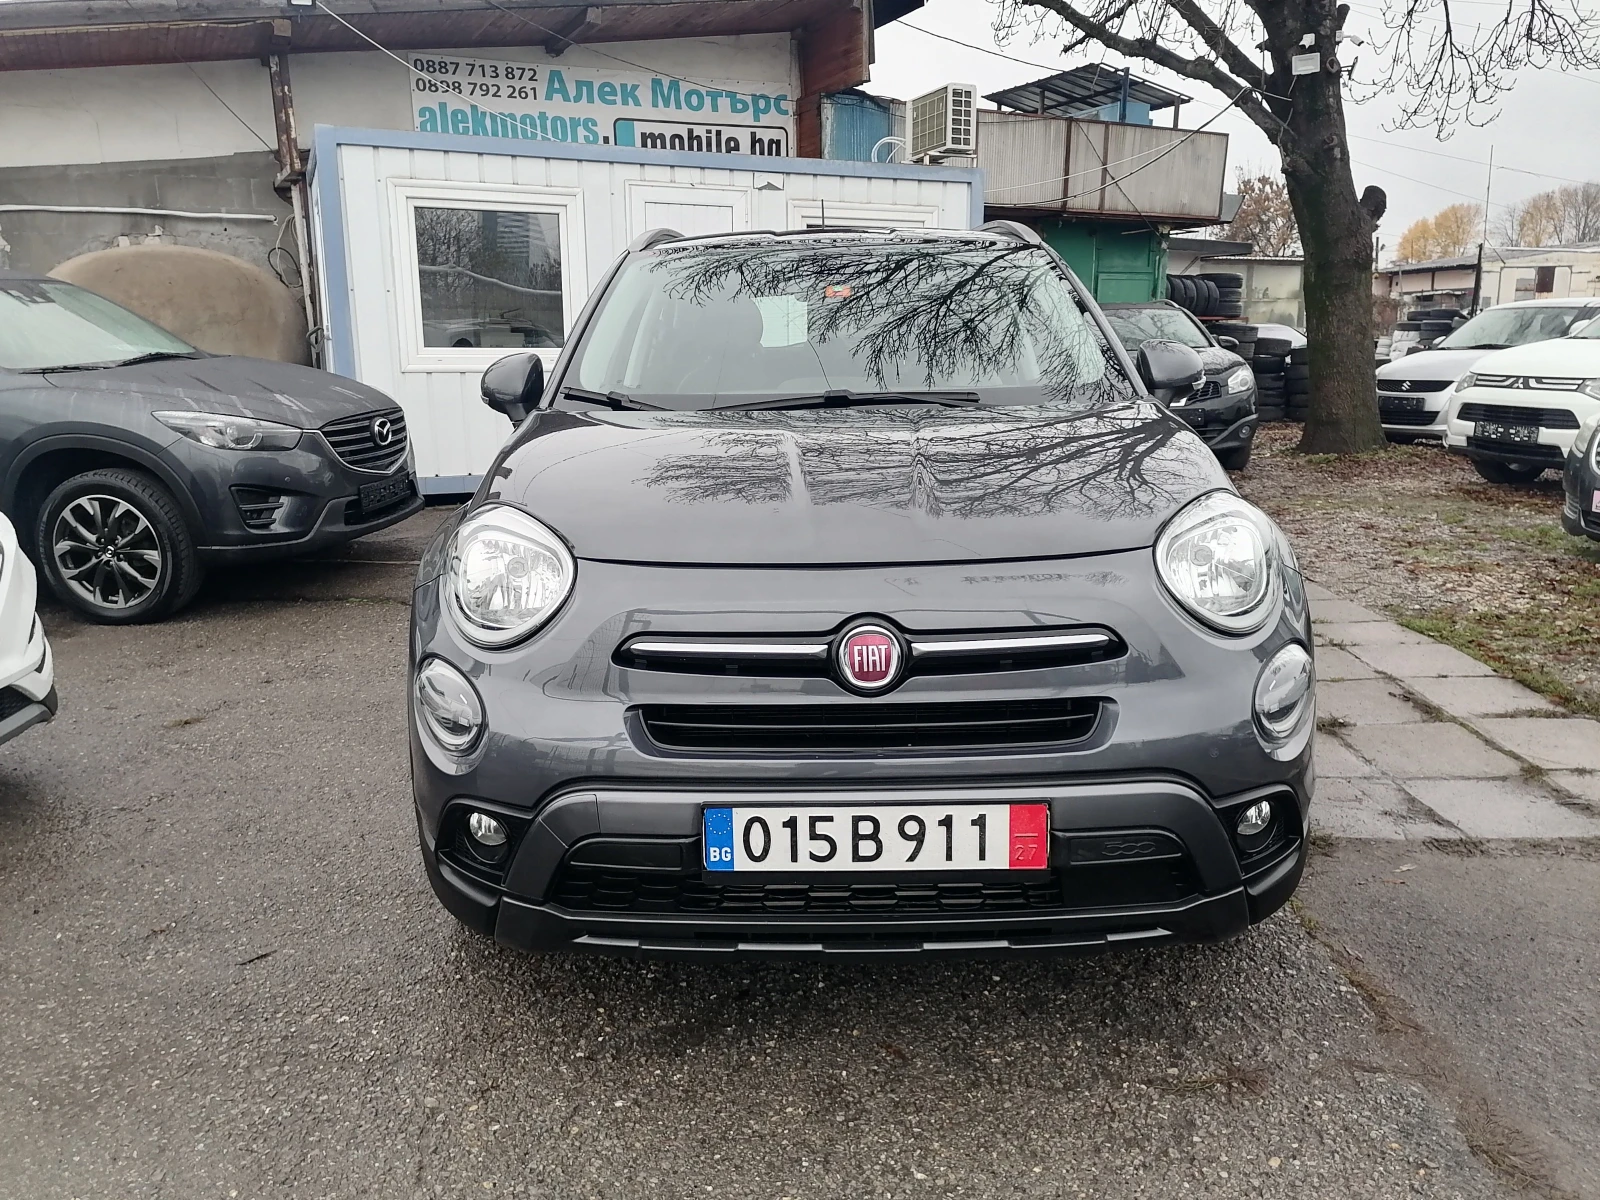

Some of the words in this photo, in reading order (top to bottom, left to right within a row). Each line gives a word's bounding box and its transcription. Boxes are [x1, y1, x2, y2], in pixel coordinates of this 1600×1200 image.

[413, 58, 460, 76] 0887
[465, 63, 500, 79] 713
[504, 66, 539, 82] 872
[415, 78, 463, 95] 0898
[467, 82, 502, 98] 792
[506, 85, 539, 101] 261
[544, 69, 642, 107] Алек
[651, 77, 790, 122] Мотърс
[853, 644, 888, 672] FIAT
[709, 846, 732, 862] BG
[1014, 844, 1038, 861] 27
